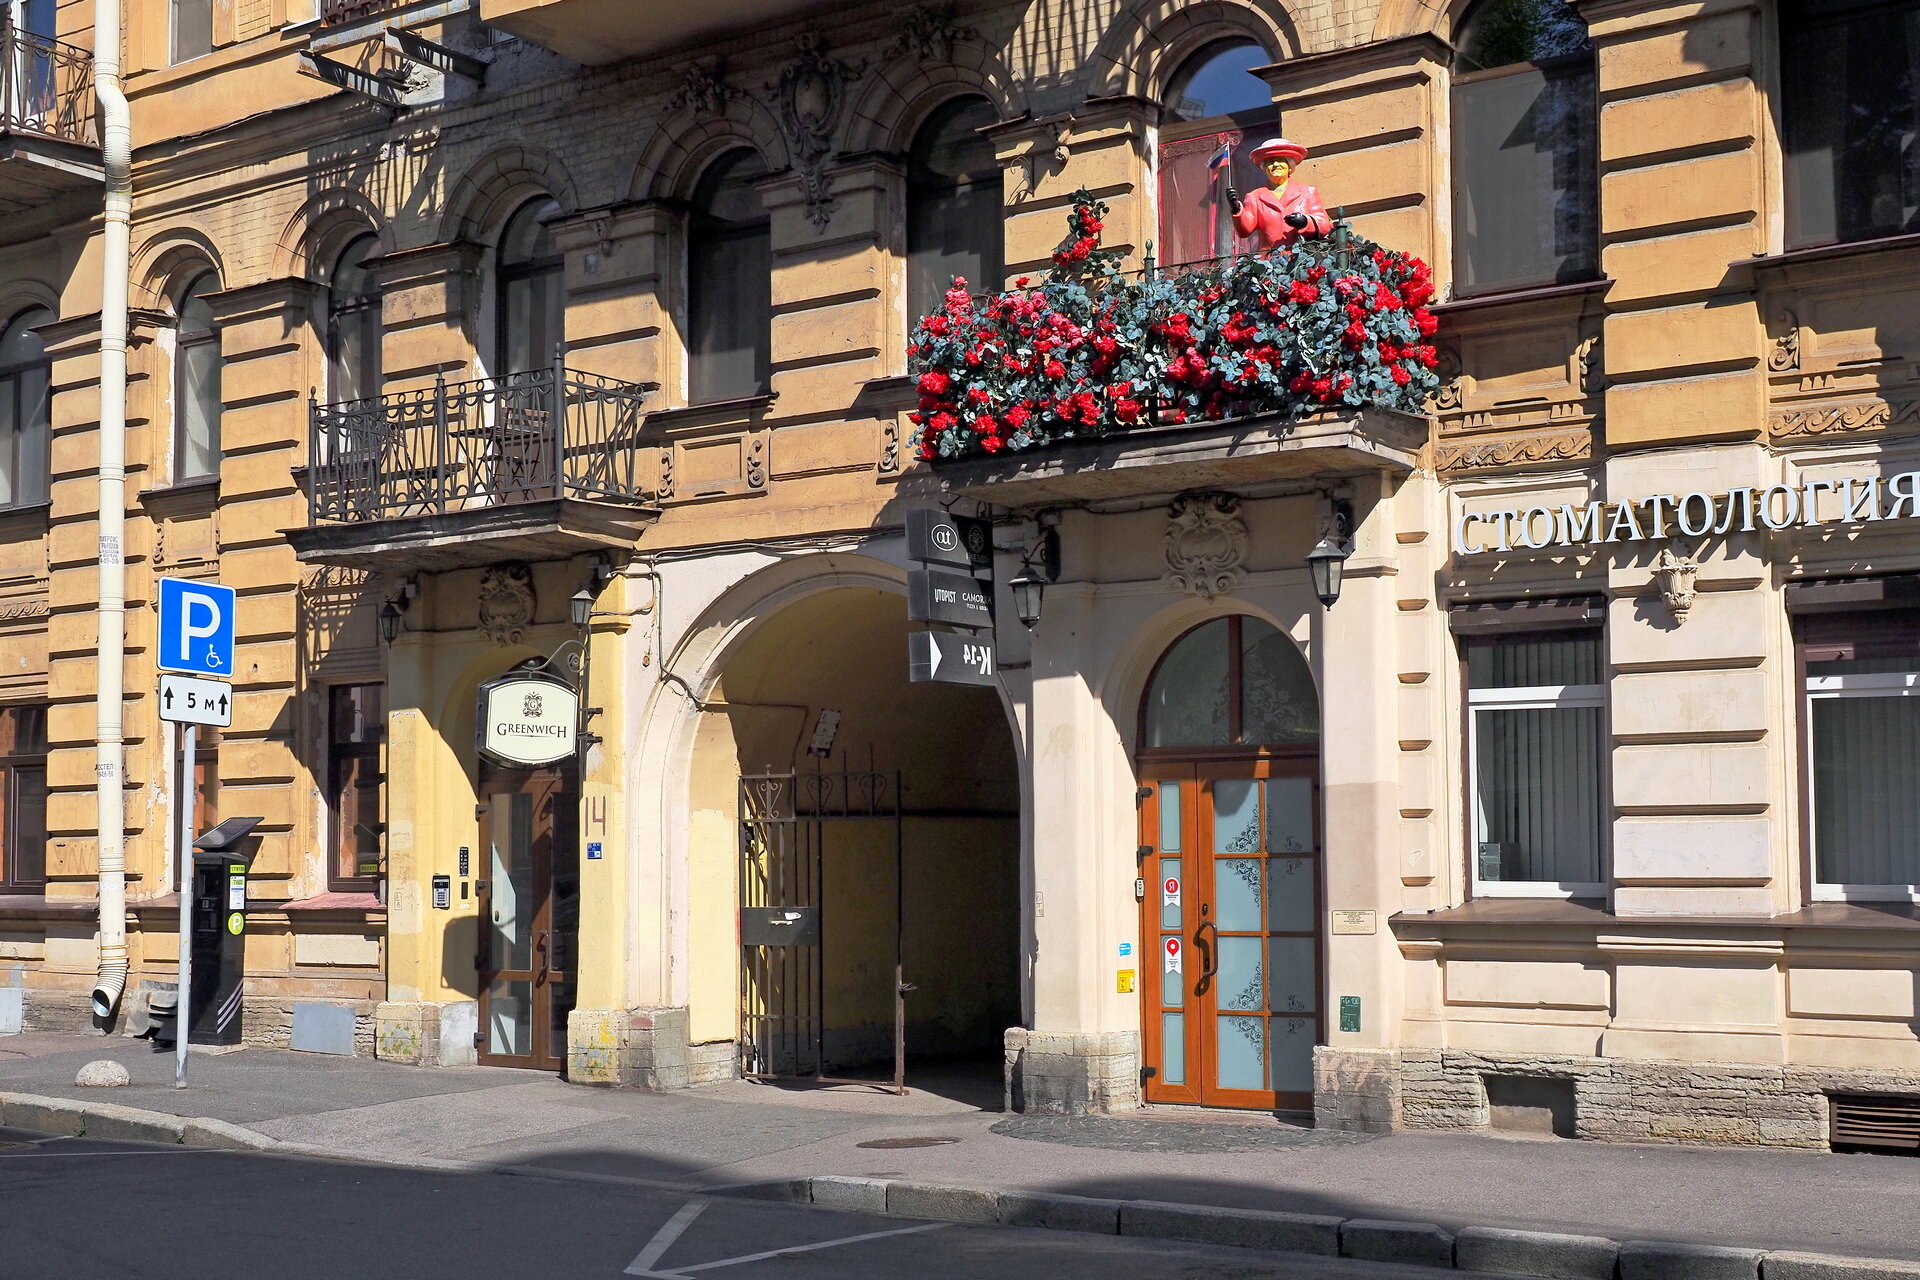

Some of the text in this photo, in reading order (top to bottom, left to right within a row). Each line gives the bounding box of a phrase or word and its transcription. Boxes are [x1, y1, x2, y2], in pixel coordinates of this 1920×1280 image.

[1456, 471, 1920, 555] СТОМАТОЛОГИЯ
[934, 588, 957, 604] UTOPIST
[962, 592, 993, 606] CAMORRA
[181, 591, 221, 661] P
[187, 692, 196, 709] 5
[496, 722, 567, 738] GREENWICH
[585, 795, 606, 838] 14
